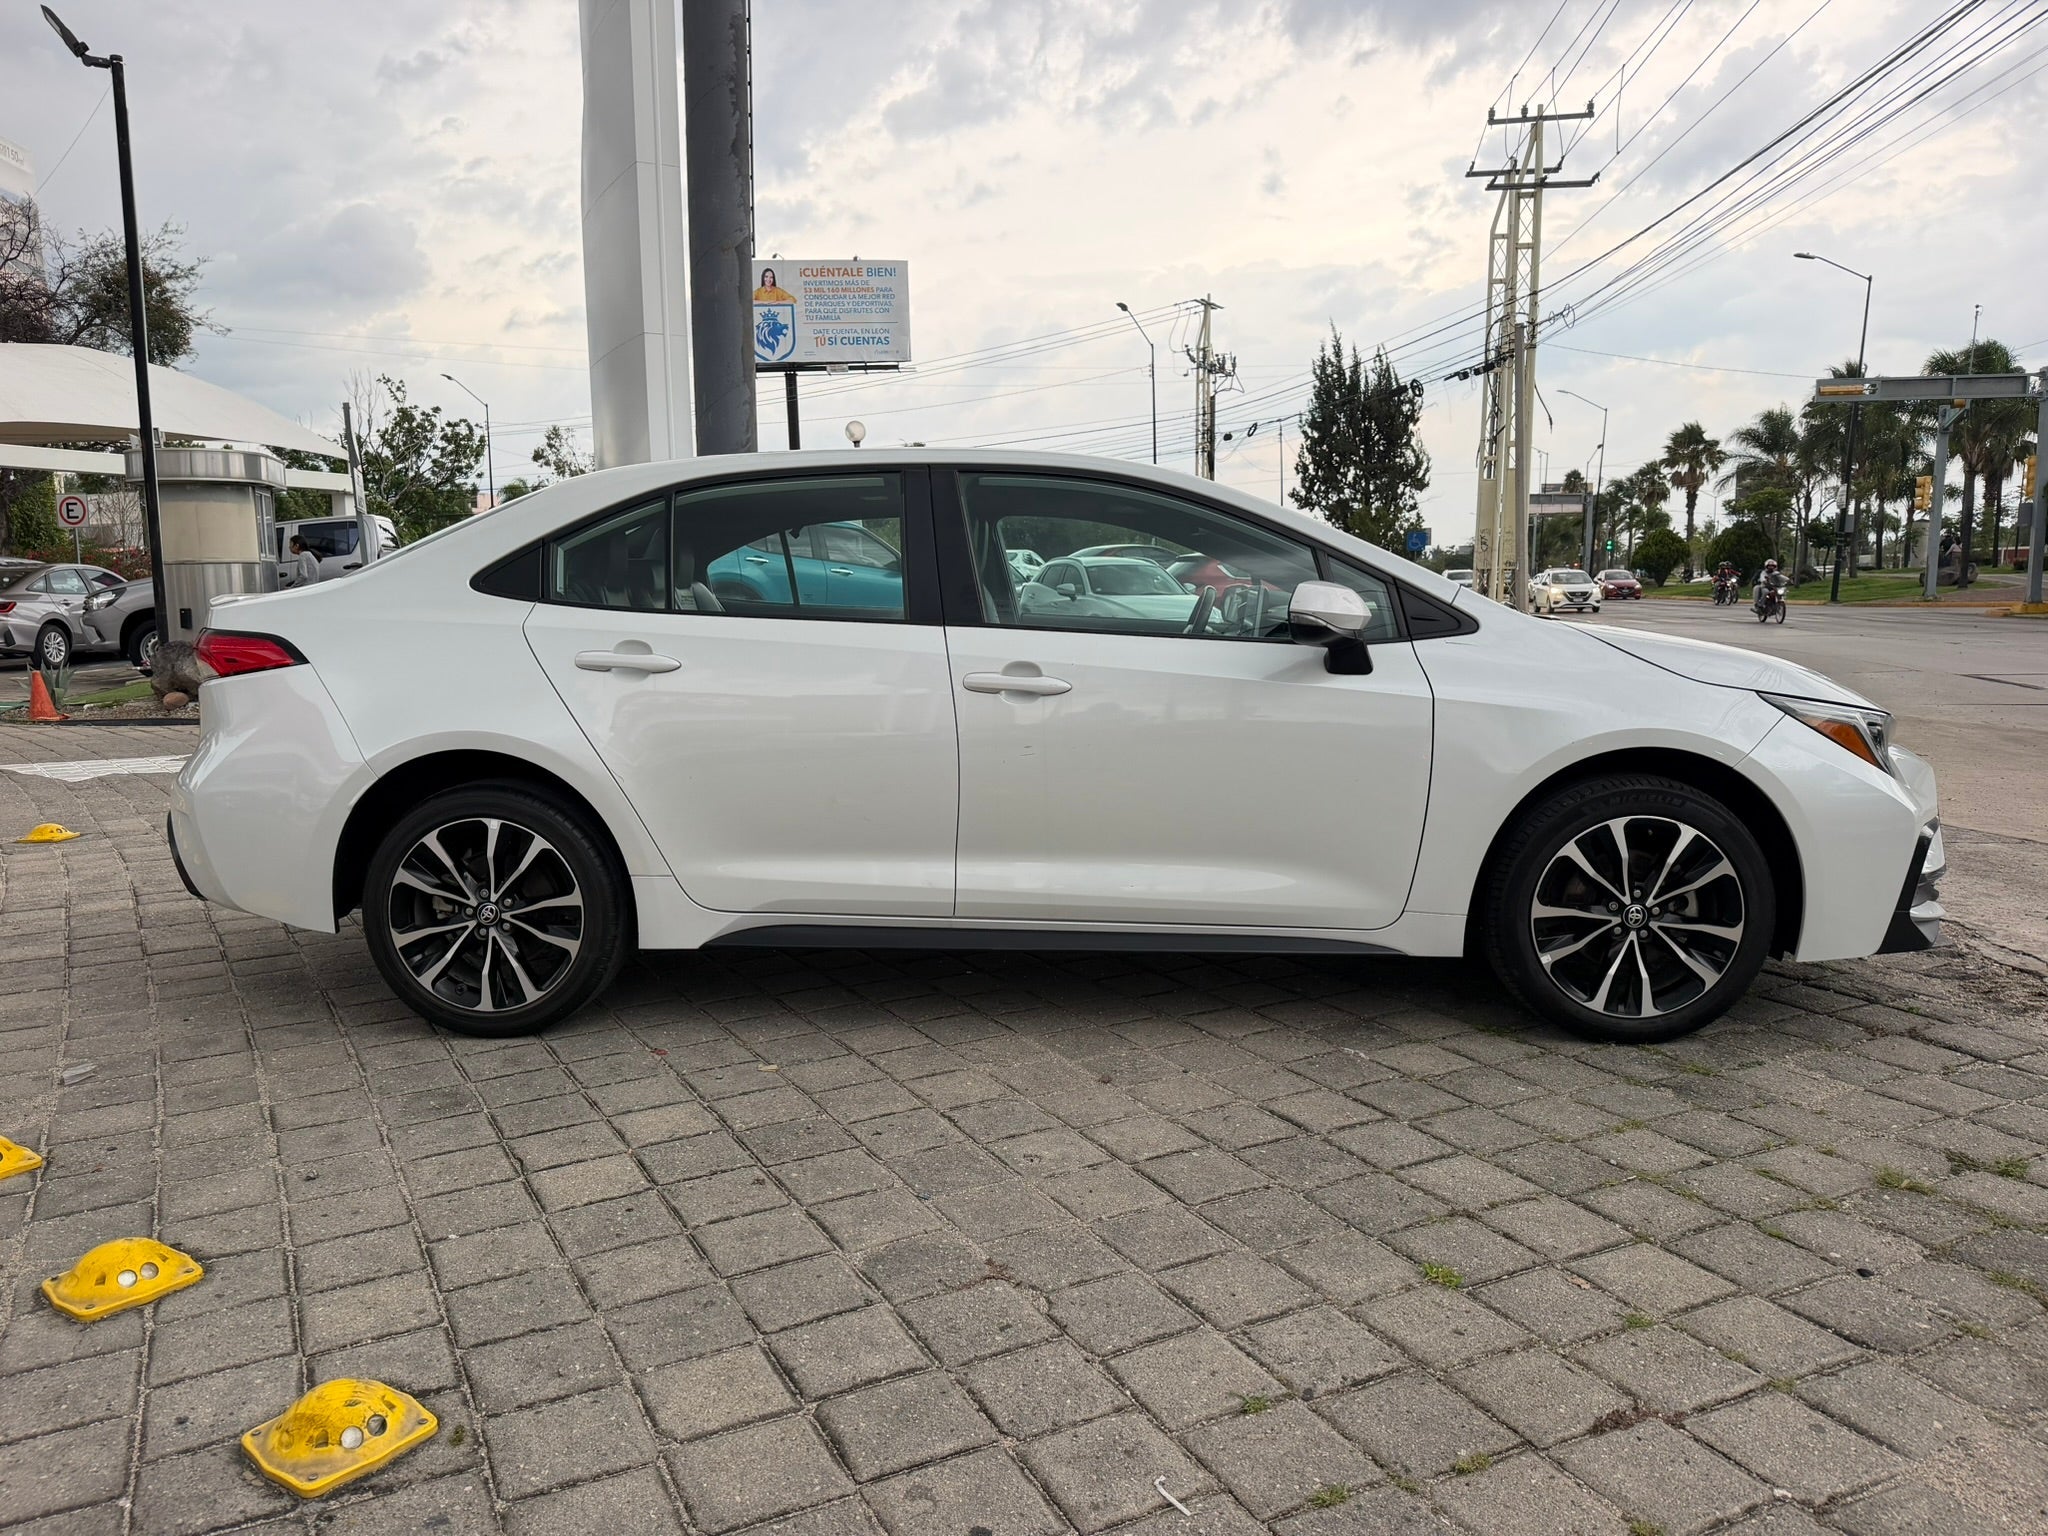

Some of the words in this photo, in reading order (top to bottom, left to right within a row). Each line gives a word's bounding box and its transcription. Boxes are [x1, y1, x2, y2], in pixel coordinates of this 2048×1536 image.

[799, 266, 863, 277] ¡CUÉNTALE
[866, 267, 896, 277] BIEN!
[814, 334, 826, 347] TÚ
[828, 335, 838, 345] SÍ
[840, 336, 890, 345] CUENTAS
[66, 502, 79, 519] E
